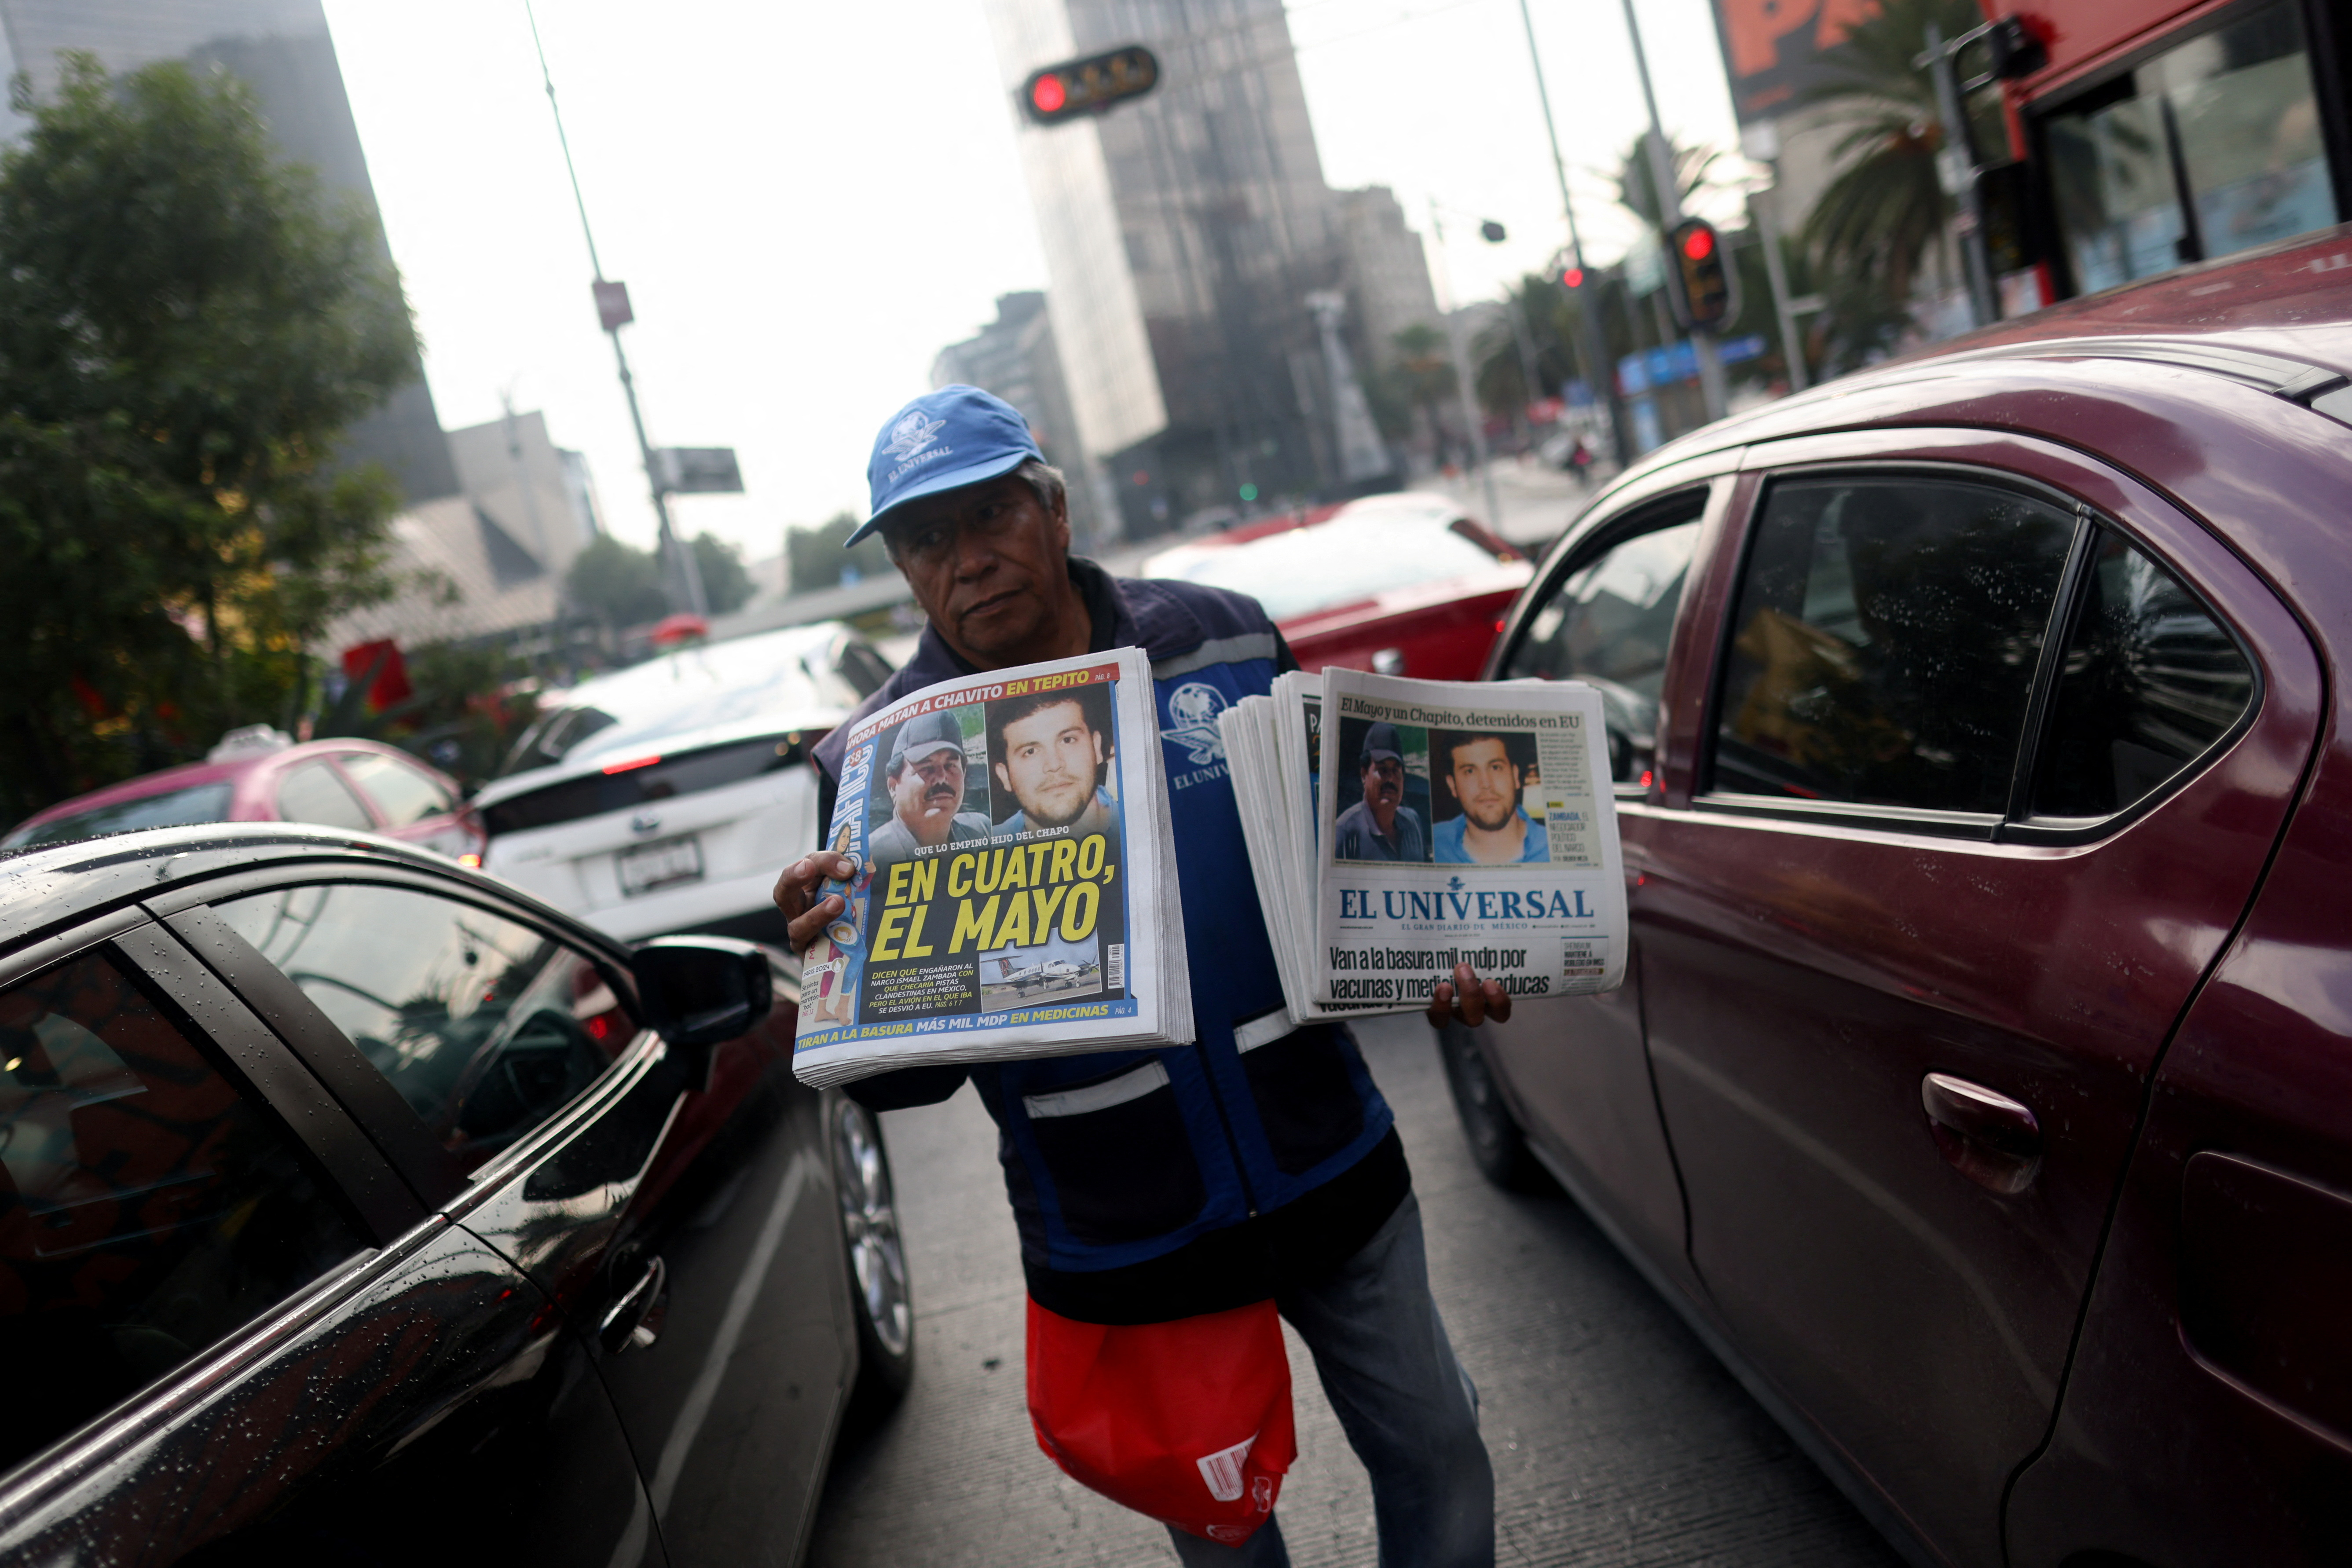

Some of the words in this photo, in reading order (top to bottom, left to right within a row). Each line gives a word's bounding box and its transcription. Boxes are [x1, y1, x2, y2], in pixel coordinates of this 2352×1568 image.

[887, 470, 898, 483] EL
[898, 446, 954, 474] UNIVERSAL
[845, 725, 876, 751] AHORA
[878, 704, 919, 732] MATAN
[920, 700, 933, 713] A
[934, 685, 1003, 709] CHAVITO
[1006, 680, 1029, 696] EN
[1033, 670, 1089, 691] TEPITO
[1095, 673, 1106, 681] PÁG.
[1341, 697, 1352, 711] El
[1354, 699, 1384, 718] Mayo
[1385, 707, 1392, 720] y
[1393, 709, 1407, 720] un
[1410, 708, 1464, 726] Chapito,
[1466, 712, 1537, 727] detenidos
[1539, 718, 1557, 728] en
[1559, 716, 1579, 728] EU
[850, 750, 861, 763] $8
[1173, 773, 1193, 790] EL
[914, 845, 933, 856] QUE
[935, 843, 947, 853] LO
[950, 836, 989, 850] EMPINÓ
[991, 834, 1013, 845] HIJO
[1015, 831, 1033, 841] DEL
[1036, 825, 1069, 838] CHAPO
[885, 859, 938, 906] EN
[947, 834, 1115, 898] CUATRO,
[1340, 889, 1377, 919] EL
[1382, 890, 1594, 920] UNIVERSAL
[869, 905, 934, 963] EL
[948, 881, 1099, 954] MAYO
[1330, 947, 1357, 970] Van
[1359, 950, 1369, 970] a
[1371, 947, 1385, 970] la
[1386, 947, 1435, 970] basura
[1436, 947, 1458, 970] mil
[1461, 947, 1497, 971] mdp
[1501, 949, 1527, 971] por
[815, 964, 830, 975] 2024
[872, 970, 897, 980] DICEN
[899, 968, 918, 977] QUE
[919, 964, 963, 975] ENGAÑARON
[806, 981, 819, 990] pinta
[871, 978, 895, 986] NARCO
[896, 976, 921, 984] ISMAEL
[923, 972, 956, 982] ZAMBADA
[900, 980, 934, 990] CHECARÍA
[935, 978, 959, 986] PISTAS
[801, 990, 811, 999] para
[875, 989, 926, 1000] CLANDESTINAS
[938, 985, 967, 993] MÉXICO,
[1330, 978, 1393, 999] vacunas
[1395, 978, 1404, 1001] y
[800, 994, 819, 1005] maratón
[898, 996, 921, 1004] AVIÓN
[888, 1004, 914, 1013] DESVIÓ
[798, 1033, 829, 1050] TIRAN
[830, 1032, 839, 1041] A
[841, 1030, 857, 1040] LA
[860, 1023, 913, 1038] BASURA
[916, 1018, 946, 1032] MÁS
[949, 1016, 974, 1029] MIL
[977, 1014, 1008, 1027] MDP
[1010, 1012, 1029, 1024] EN
[1032, 1005, 1109, 1022] MEDICINAS
[1115, 1006, 1126, 1015] PÁG.
